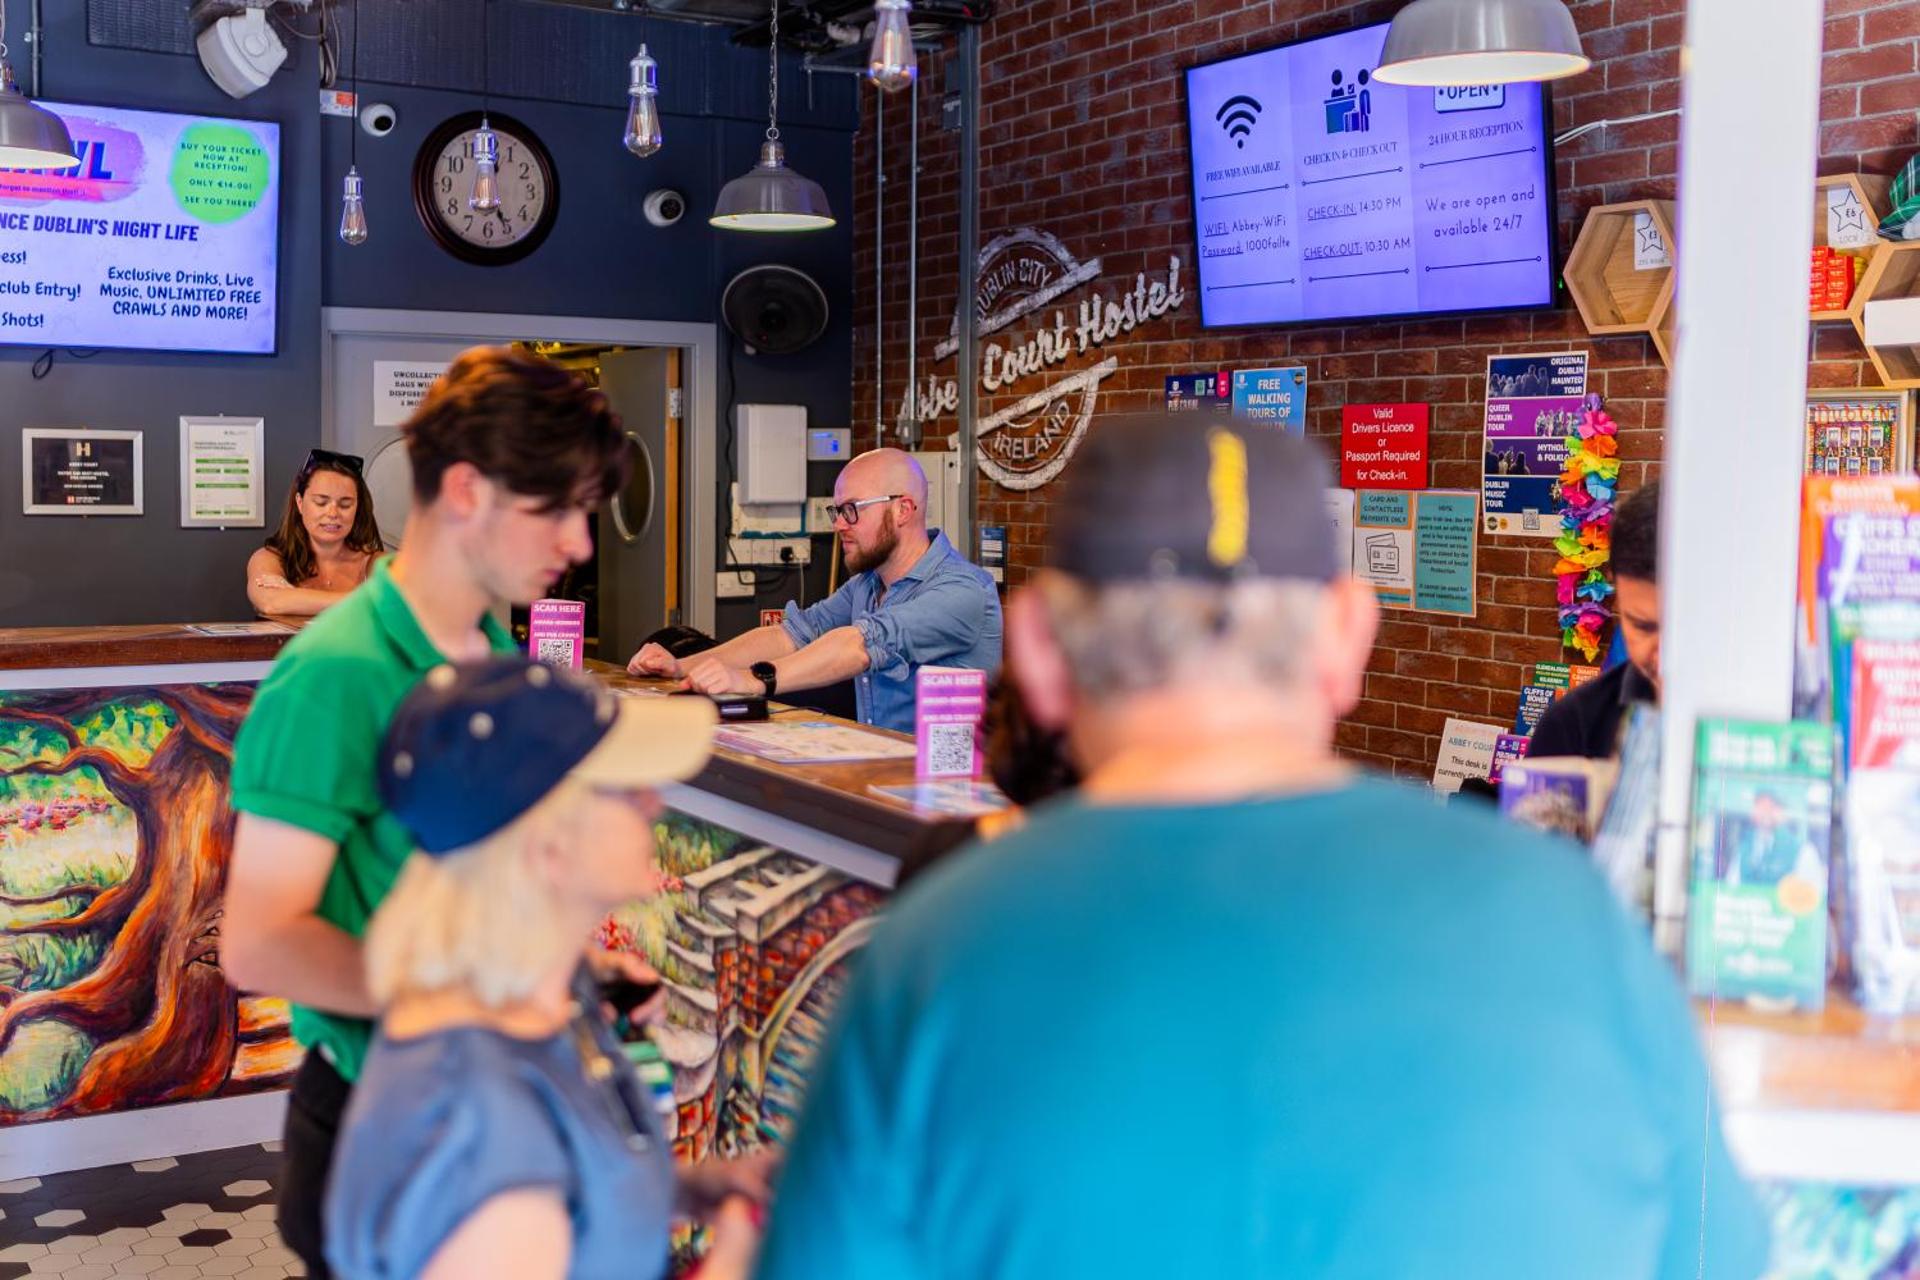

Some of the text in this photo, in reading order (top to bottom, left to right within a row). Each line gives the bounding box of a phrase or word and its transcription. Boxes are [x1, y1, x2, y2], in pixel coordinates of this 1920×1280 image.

[1447, 85, 1490, 99] OPEN
[1440, 130, 1468, 144] HOUR
[1469, 120, 1524, 139] RECEPTION
[181, 142, 261, 156] BUY YOUR TICKET
[507, 146, 513, 162] 1
[1304, 152, 1332, 166] CHECK
[1350, 145, 1378, 158] CHECK
[1379, 142, 1398, 153] OUT
[194, 162, 248, 172] RECEPTION!
[447, 156, 464, 174] 10
[519, 162, 530, 180] 2
[1206, 171, 1225, 182] FREE
[1242, 160, 1281, 177] AVAILABLE
[188, 178, 213, 187] ONLY
[441, 176, 452, 194] 9
[526, 182, 536, 200] 3
[226, 200, 256, 208] THERE!
[1386, 196, 1402, 208] PM
[1426, 184, 1535, 212] We are open and
[448, 198, 458, 216] 8
[517, 204, 527, 222] 4
[33, 215, 108, 236] DUBLIN'S
[112, 221, 162, 239] NIGHT
[164, 224, 200, 242] LIFE
[464, 214, 474, 232] 7
[502, 218, 512, 235] 5
[1232, 214, 1287, 233] Abbey-WiFi
[1434, 214, 1523, 238] available 24/7
[482, 221, 494, 239] 6
[1393, 236, 1410, 249] AM
[2, 251, 27, 264] ess!
[108, 266, 254, 286] Exclusive Drinks, Live
[1018, 257, 1053, 289] CITY
[0, 282, 82, 301] club Entry!
[100, 284, 262, 304] Music, UNLIMITED FREE
[113, 301, 248, 320] CRAWLS AND MORE!
[2, 312, 44, 328] Shots!
[982, 311, 1071, 392] Court
[1075, 255, 1186, 352] Hostel
[1550, 356, 1584, 366] ORIGINAL
[1558, 366, 1584, 375] DUBLIN
[1258, 378, 1280, 390] FREE
[1551, 376, 1584, 385] HAUNTED
[1564, 386, 1584, 394] TOUR
[1248, 392, 1291, 404] WALKING
[1247, 407, 1292, 418] TOURS OF
[1372, 408, 1394, 419] Valid
[1488, 404, 1510, 412] QUEER
[1488, 414, 1513, 422] DUBLIN
[993, 400, 1072, 460] IRELAND
[1352, 422, 1414, 434] Drivers Licence
[1488, 422, 1506, 431] TOUR
[1378, 438, 1387, 447] or
[1346, 450, 1420, 464] Passport Required
[1827, 447, 1880, 458] ABBEY
[1356, 470, 1408, 480] for Check-in.
[1485, 480, 1509, 490] DUBLIN
[1485, 490, 1506, 499] MUSIC
[1486, 499, 1504, 508] TOUR
[534, 604, 582, 612] SCAN HERE
[923, 674, 981, 686] SCAN HERE
[1524, 686, 1544, 696] CLIFFS
[1448, 736, 1472, 747] ABBEY
[1452, 756, 1464, 766] This
[1465, 760, 1481, 769] desk
[1438, 768, 1466, 780] currently
